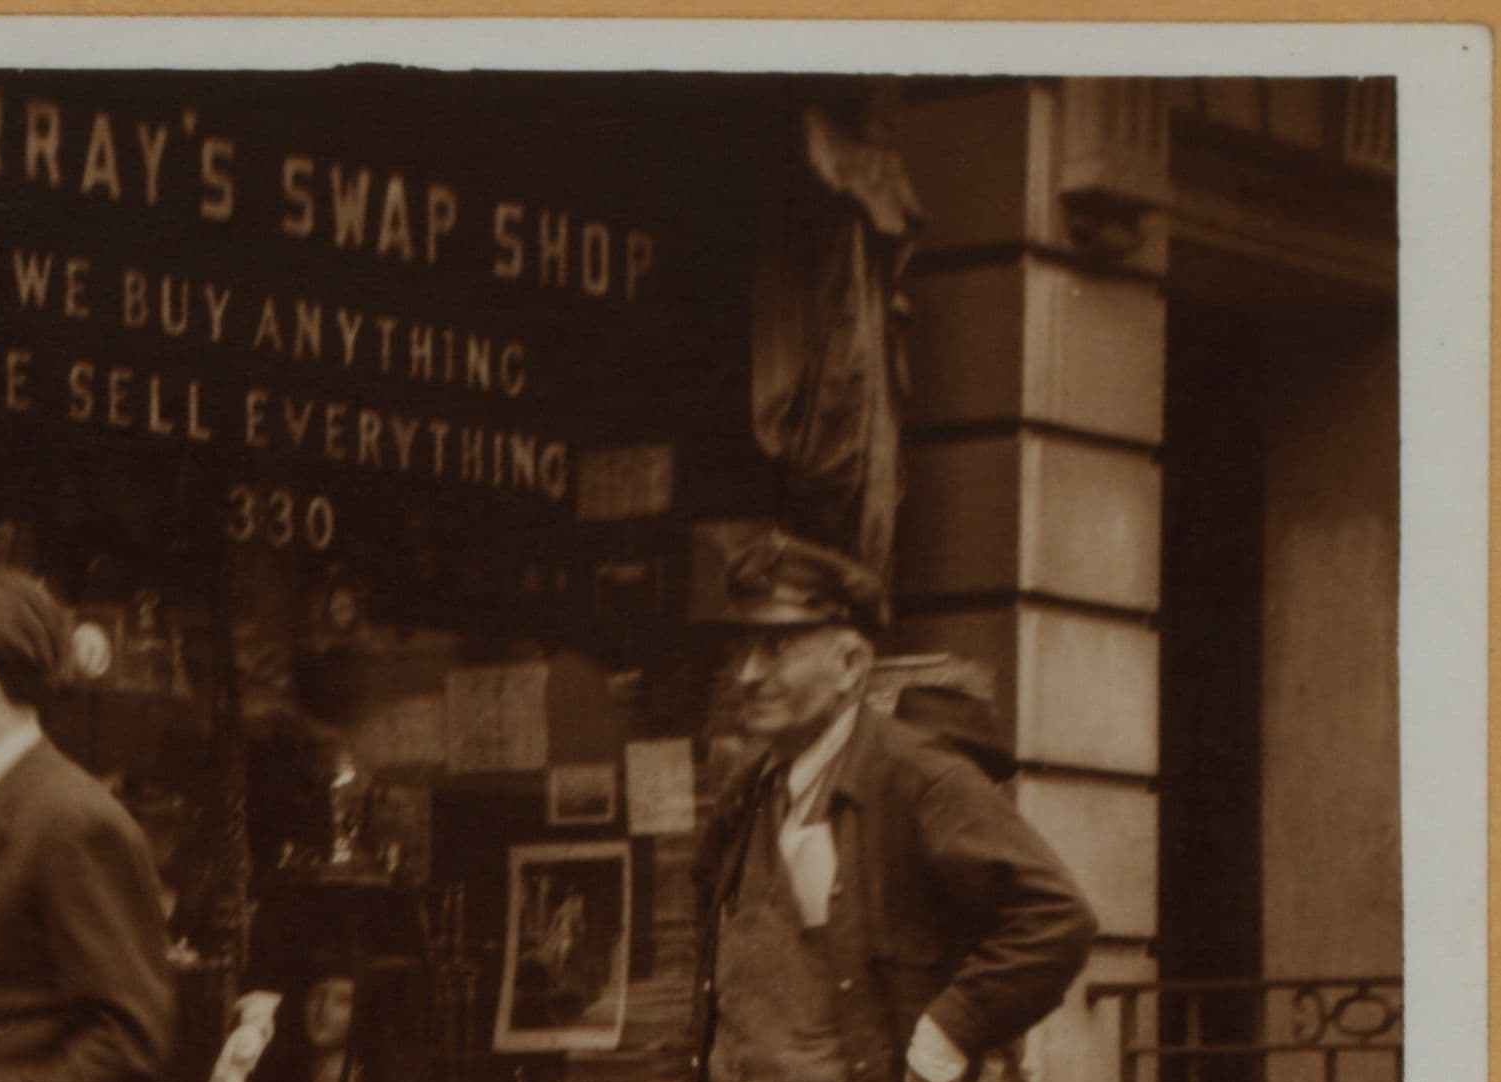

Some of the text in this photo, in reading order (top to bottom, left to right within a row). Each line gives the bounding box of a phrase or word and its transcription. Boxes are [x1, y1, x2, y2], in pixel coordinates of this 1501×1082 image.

[283, 157, 457, 265] SWAP
[494, 204, 653, 301] SHOP
[12, 248, 526, 397] WE BUY ANYTHING
[68, 360, 211, 442] SELL
[244, 388, 568, 500] EVERYTHING
[228, 484, 334, 551] 330
